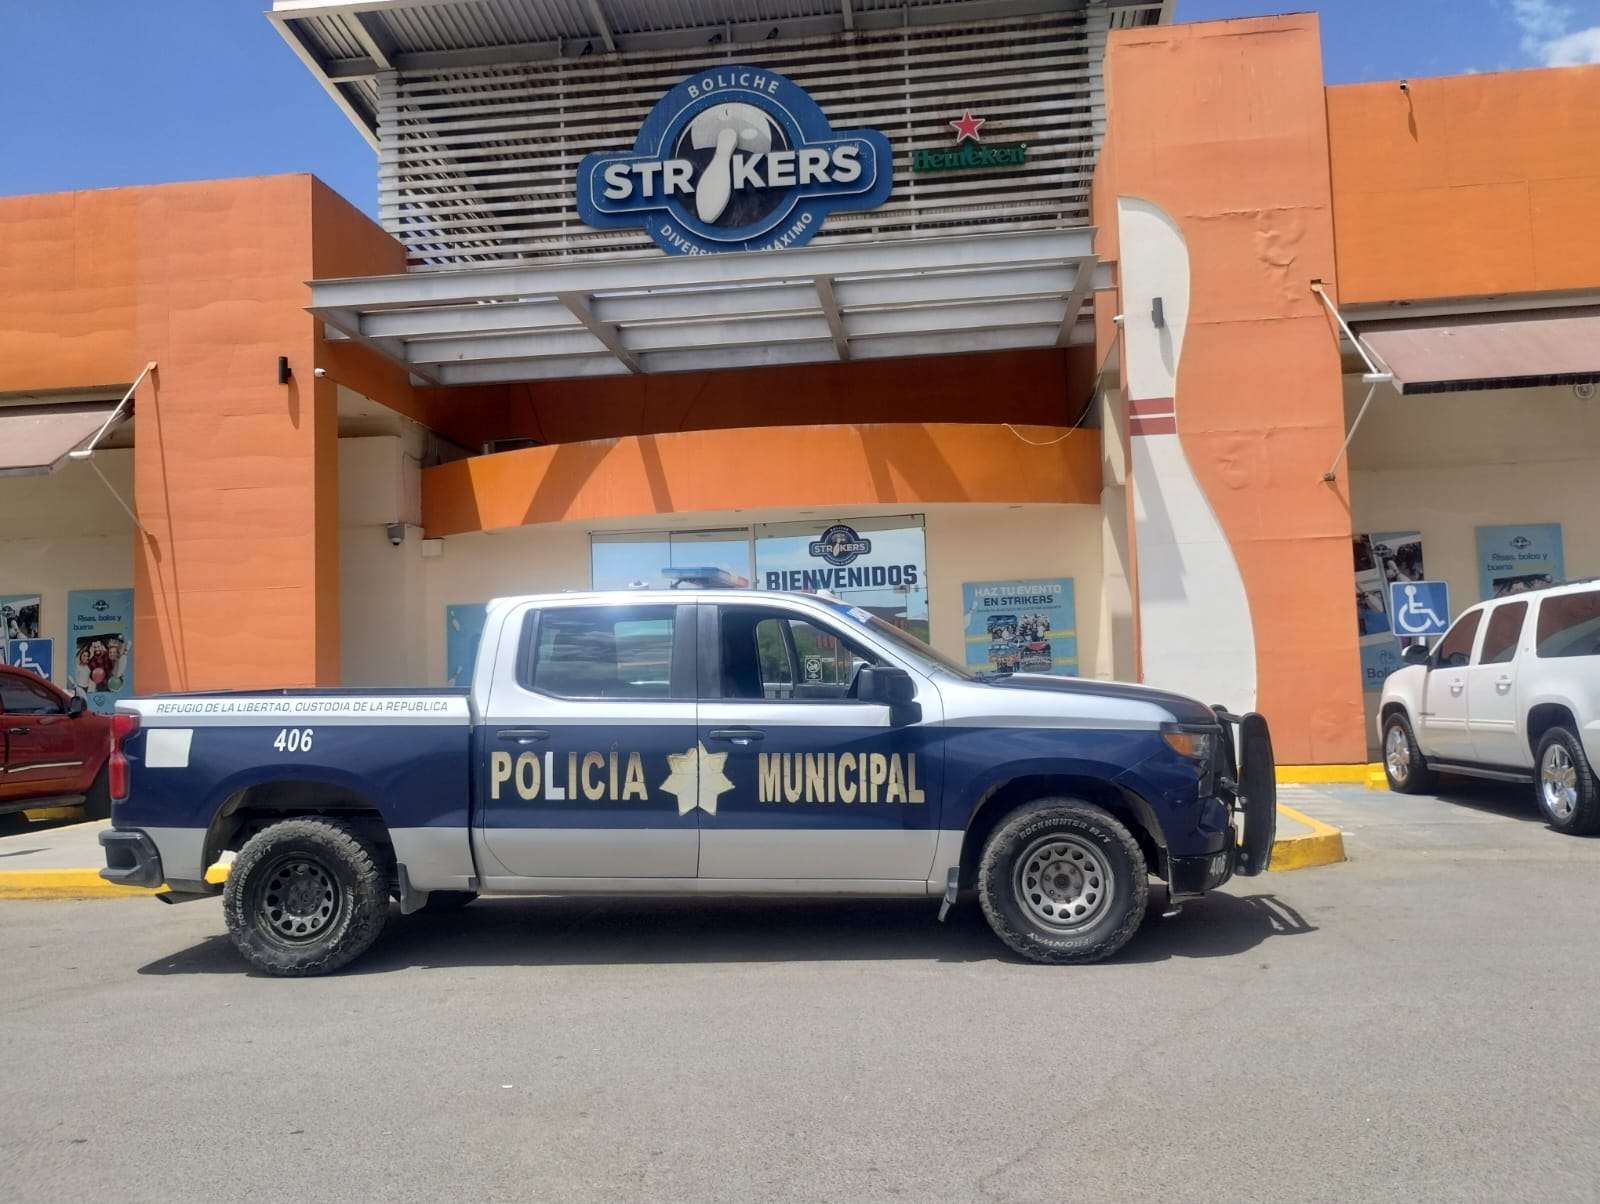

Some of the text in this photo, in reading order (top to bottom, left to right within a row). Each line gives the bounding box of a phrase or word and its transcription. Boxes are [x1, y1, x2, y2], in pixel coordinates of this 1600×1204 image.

[688, 72, 780, 98] BOLICHE
[912, 143, 1026, 172] Heineken
[766, 564, 918, 592] BIENVENIDOS
[975, 584, 1062, 597] HAZ TU EVENTO
[984, 595, 1054, 607] EN STRIKERS
[156, 701, 449, 714] REFUGIO DE LA LIBERTAD, CUSTODIA DE LA REPUBLICA
[273, 728, 314, 752] 406
[758, 751, 925, 804] MUNICIPAL
